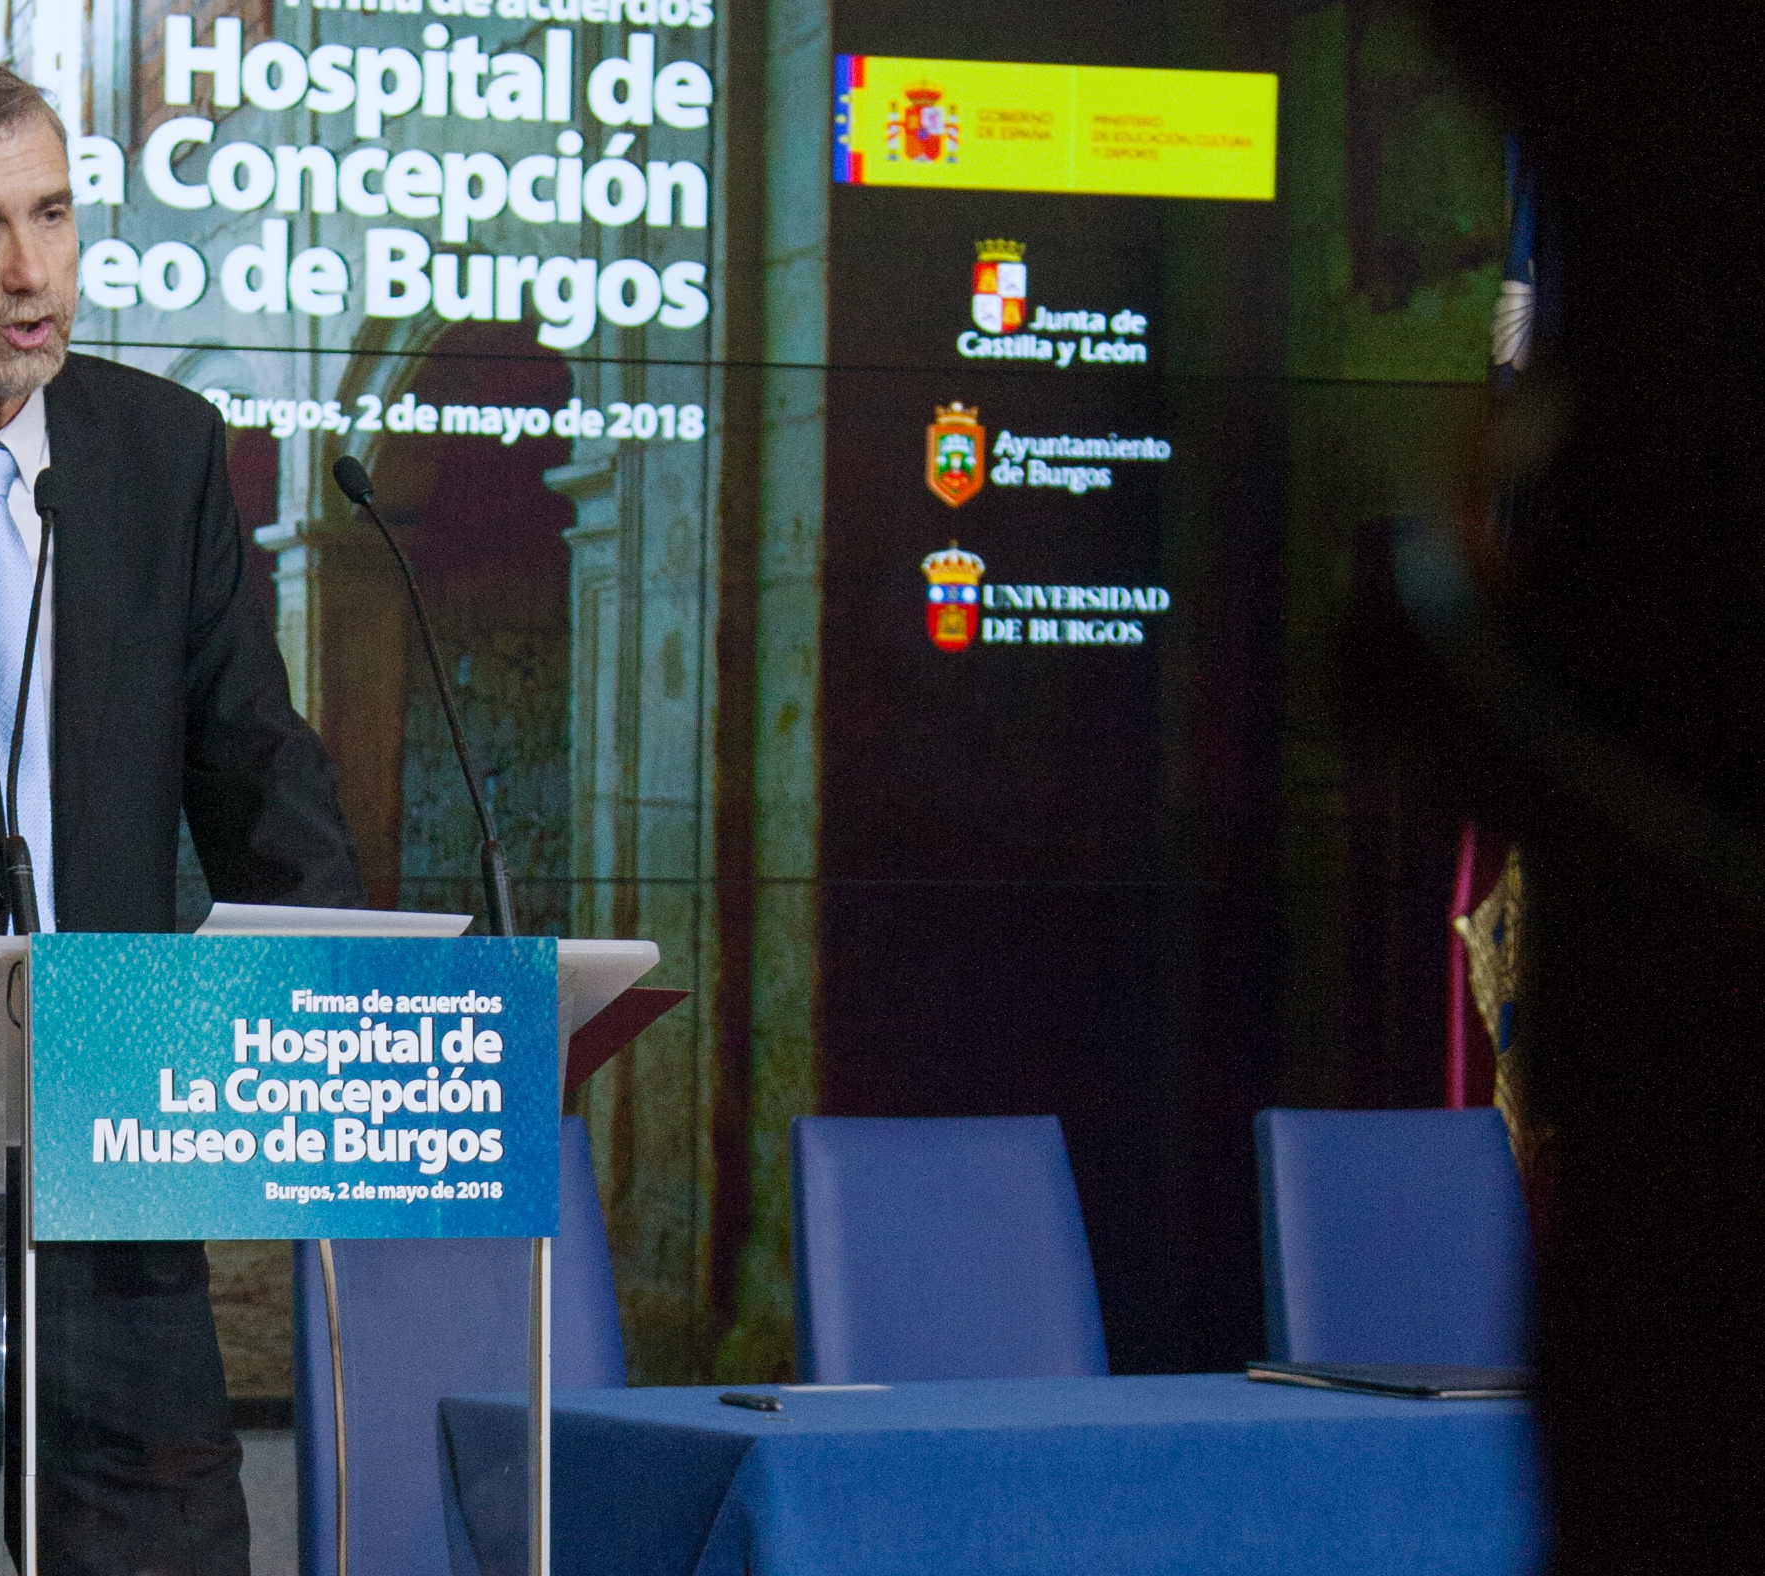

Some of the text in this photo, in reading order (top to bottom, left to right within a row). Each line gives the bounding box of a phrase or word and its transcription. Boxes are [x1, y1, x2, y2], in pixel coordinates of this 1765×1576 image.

[164, 14, 714, 139] Hospital de
[71, 116, 709, 244] a Concepción
[220, 220, 348, 316] de
[365, 227, 710, 348] Burgos
[1029, 305, 1147, 334] Junta de
[956, 330, 1146, 368] Castilla y León
[354, 393, 383, 431] 2
[386, 393, 437, 433] de
[440, 404, 549, 445] mayo
[553, 399, 606, 436] de
[608, 402, 705, 440] 2018
[993, 430, 1171, 462] Ayuntamiento
[991, 458, 1112, 495] de Burgos
[982, 585, 1170, 611] UNIVERSIDAD
[982, 618, 1144, 644] DE BURGOS
[291, 989, 502, 1014] Firma de acuerdos
[234, 1017, 502, 1074] Hospital de
[159, 1067, 501, 1123] La Concepción
[92, 1115, 503, 1174] Museo de Burgos
[265, 1181, 502, 1204] Burgos, 2 de mayo de 2018
